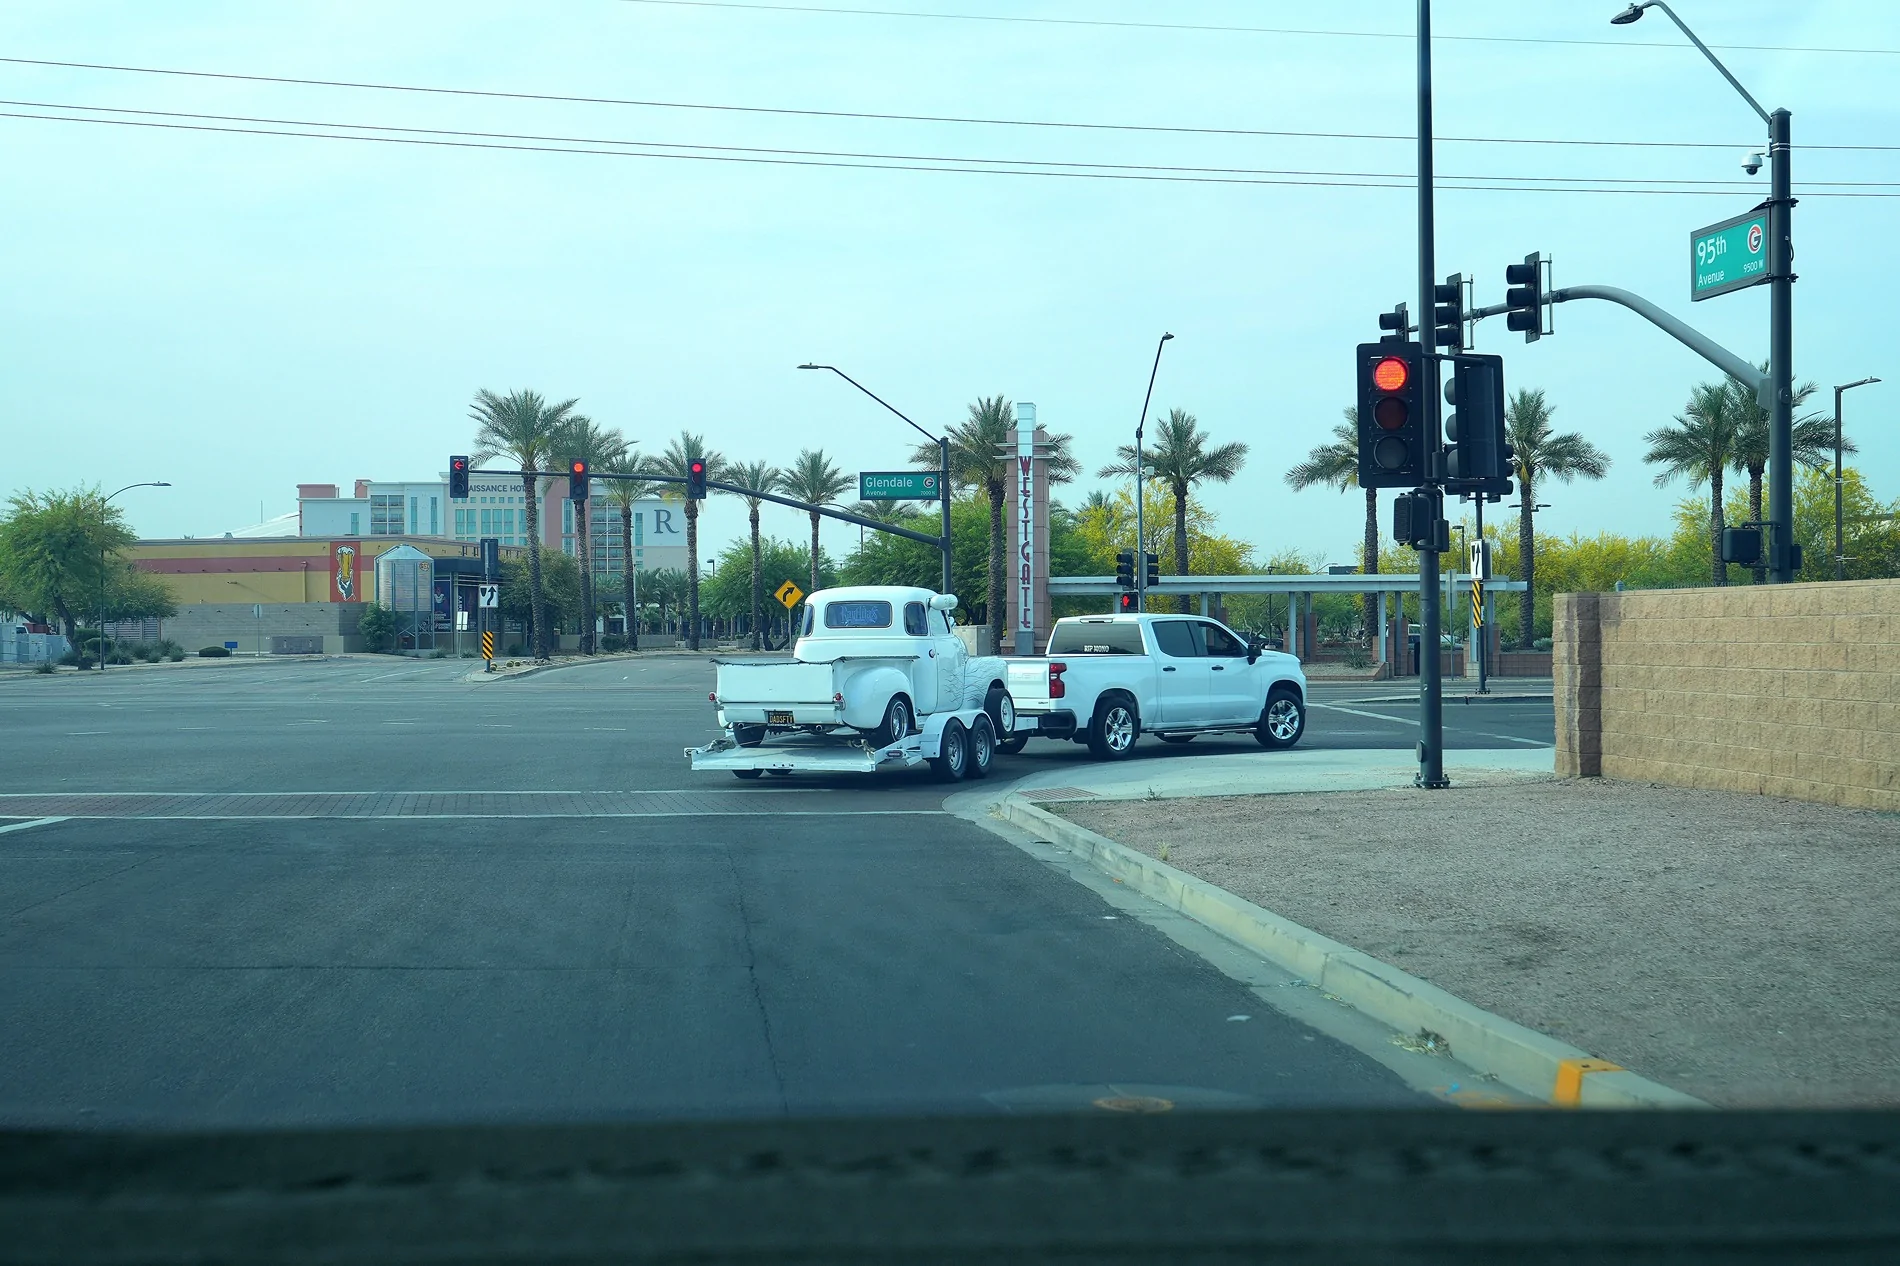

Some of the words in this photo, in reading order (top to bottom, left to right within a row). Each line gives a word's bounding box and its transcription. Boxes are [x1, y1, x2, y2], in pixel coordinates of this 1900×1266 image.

[1697, 235, 1727, 266] 95th
[1743, 260, 1758, 273] 9500
[1698, 270, 1725, 287] Avenue
[468, 484, 508, 492] AISSANCE
[510, 484, 526, 492] HOT
[865, 477, 913, 488] Glendale
[653, 509, 680, 534] R
[1018, 456, 1032, 629] WESTGATE
